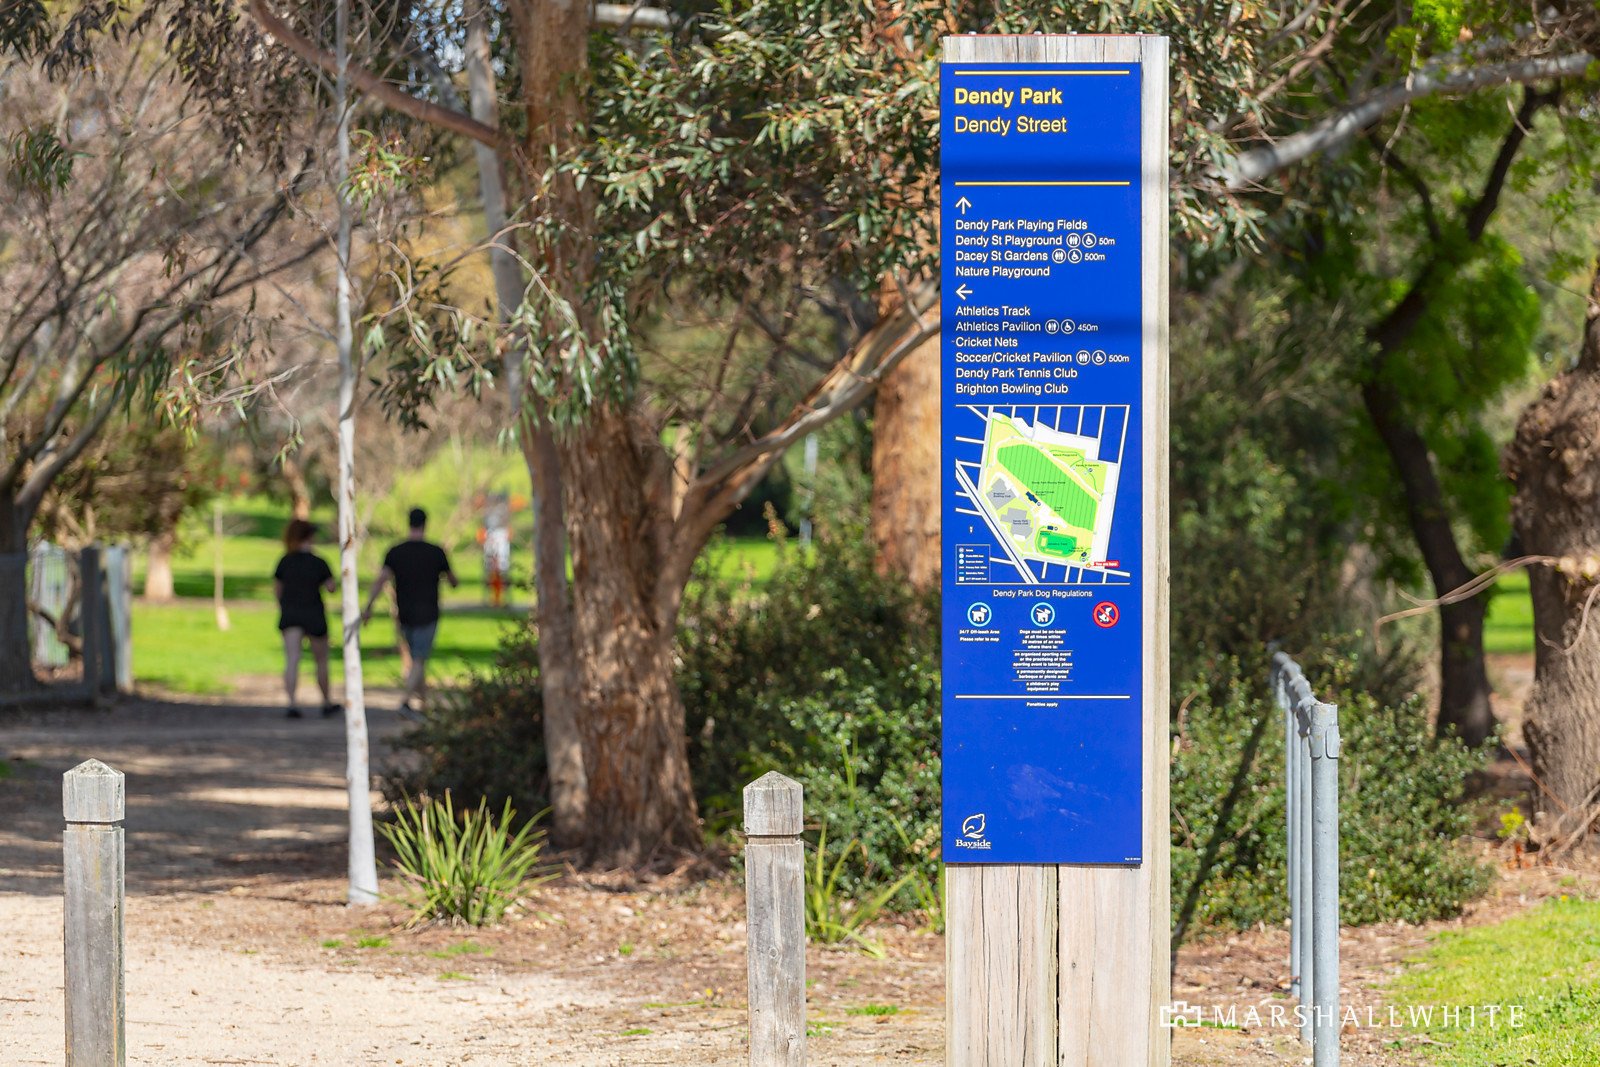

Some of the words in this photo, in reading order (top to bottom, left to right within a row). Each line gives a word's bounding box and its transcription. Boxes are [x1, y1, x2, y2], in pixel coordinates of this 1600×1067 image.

[955, 87, 1014, 108] Dendy
[1020, 87, 1063, 104] Park
[955, 116, 1011, 136] Dendy
[1017, 115, 1067, 133] Street
[955, 219, 989, 232] Dendy
[991, 219, 1015, 230] Park
[1017, 219, 1054, 232] Playing
[1057, 219, 1088, 230] Fields
[955, 235, 989, 247] Dendy
[991, 234, 1002, 246] St
[1004, 235, 1062, 248] Playground
[1098, 237, 1115, 245] 50m
[955, 250, 989, 263] Dacey
[991, 250, 1002, 261] St
[1004, 250, 1048, 261] Gardens
[1084, 252, 1106, 261] 500m
[955, 266, 990, 276] Nature
[992, 266, 1050, 279] Playground
[955, 306, 999, 316] Athletics
[1001, 305, 1031, 316] Track
[955, 321, 999, 332] Athletics
[1002, 321, 1041, 331] Pavilion
[1077, 323, 1098, 331] 450m
[955, 336, 992, 347] Cricket
[994, 337, 1018, 347] Nets
[956, 352, 1031, 363] Soccer/Cricket
[1033, 352, 1072, 363] Pavilion
[1108, 354, 1130, 362] 500m
[956, 367, 990, 380] Dendy
[992, 367, 1015, 378] Park
[1017, 367, 1051, 378] Tennis
[1053, 367, 1078, 378] Club
[956, 383, 999, 396] Brighton
[1001, 383, 1042, 396] Bowling
[1044, 383, 1069, 394] Club
[993, 589, 1016, 598] Dendy
[1018, 589, 1034, 597] Park
[1035, 589, 1051, 598] Dog
[1052, 589, 1093, 598] Regulations
[956, 839, 991, 849] Bayside
